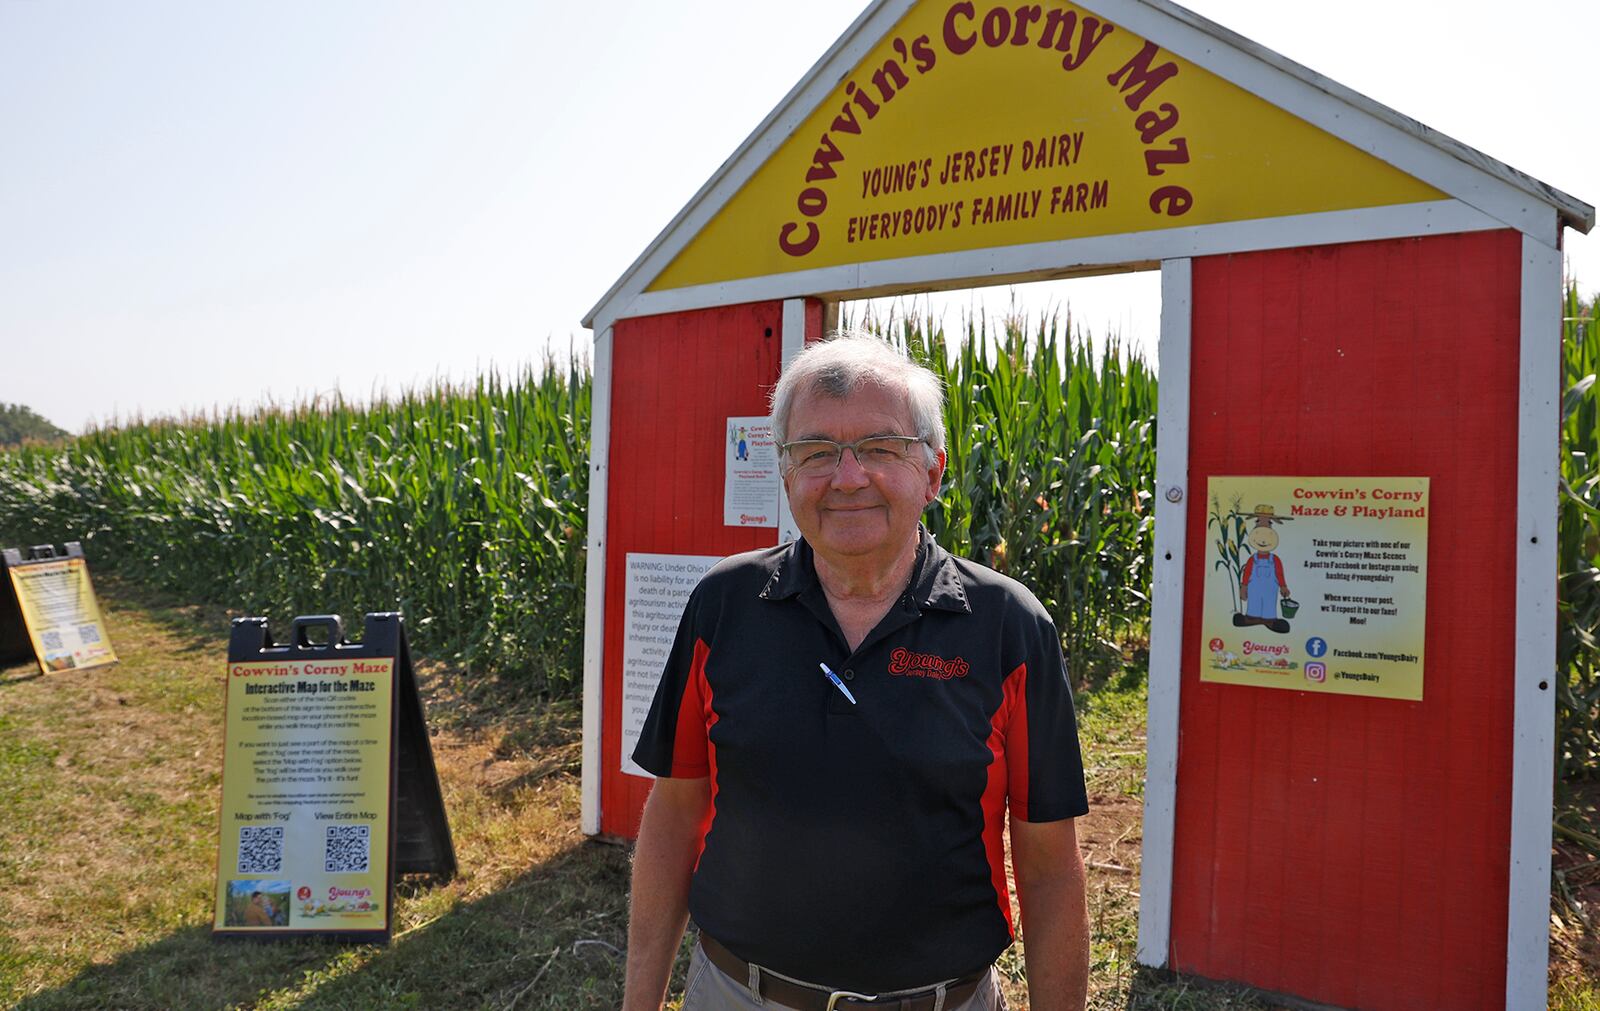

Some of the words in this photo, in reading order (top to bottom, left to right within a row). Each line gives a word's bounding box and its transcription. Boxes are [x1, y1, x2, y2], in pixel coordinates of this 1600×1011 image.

[778, 34, 936, 258] Cowvin's
[942, 1, 1114, 72] Corny
[1106, 39, 1194, 217] Maze
[862, 157, 933, 199] YOUNG'S
[940, 144, 1014, 185] JERSEY
[1022, 131, 1086, 172] DAIRY
[847, 201, 963, 244] EVERYBODY'S
[971, 189, 1043, 226] FAMILY
[1050, 179, 1109, 215] FARM
[1293, 487, 1367, 499] Cowvin's
[1372, 488, 1424, 502] Corny
[1290, 505, 1329, 516] Maze
[1334, 505, 1348, 517] &
[1352, 505, 1425, 519] Playland
[1312, 539, 1328, 547] Take
[1343, 540, 1364, 549] picture
[1393, 541, 1400, 549] of
[1315, 550, 1343, 558] Cowvin's
[1344, 551, 1363, 560] Corny
[1363, 551, 1382, 559] Maze
[1382, 552, 1407, 560] Scenes
[664, 564, 686, 572] Under
[687, 564, 704, 573] Ohio
[1330, 561, 1360, 570] Facebook
[1368, 563, 1401, 572] Instagram
[1402, 565, 1419, 573] using
[650, 576, 673, 586] liability
[675, 576, 685, 585] for
[1325, 572, 1350, 581] hashtag
[1351, 574, 1394, 583] #youngsdairy
[639, 587, 658, 595] death
[658, 587, 666, 595] of
[1324, 593, 1341, 602] When
[629, 599, 666, 609] agritourism
[1336, 606, 1356, 614] repost
[1349, 617, 1367, 625] Moo!
[1242, 640, 1290, 656] Young's
[1333, 649, 1419, 664] Facebook.com/YoungsDairy
[888, 646, 970, 680] Young's
[233, 664, 300, 677] Cowvin's
[304, 664, 348, 677] Corny
[353, 662, 389, 673] Maze
[637, 670, 649, 678] not
[245, 681, 296, 695] Interactive
[296, 681, 318, 697] Map
[319, 681, 333, 693] for
[333, 680, 348, 692] the
[349, 679, 376, 692] Maze
[234, 812, 253, 821] Map
[253, 812, 272, 820] with
[314, 811, 334, 820] View
[335, 810, 358, 820] Entire
[359, 811, 378, 821] Map
[328, 885, 372, 901] Young's
